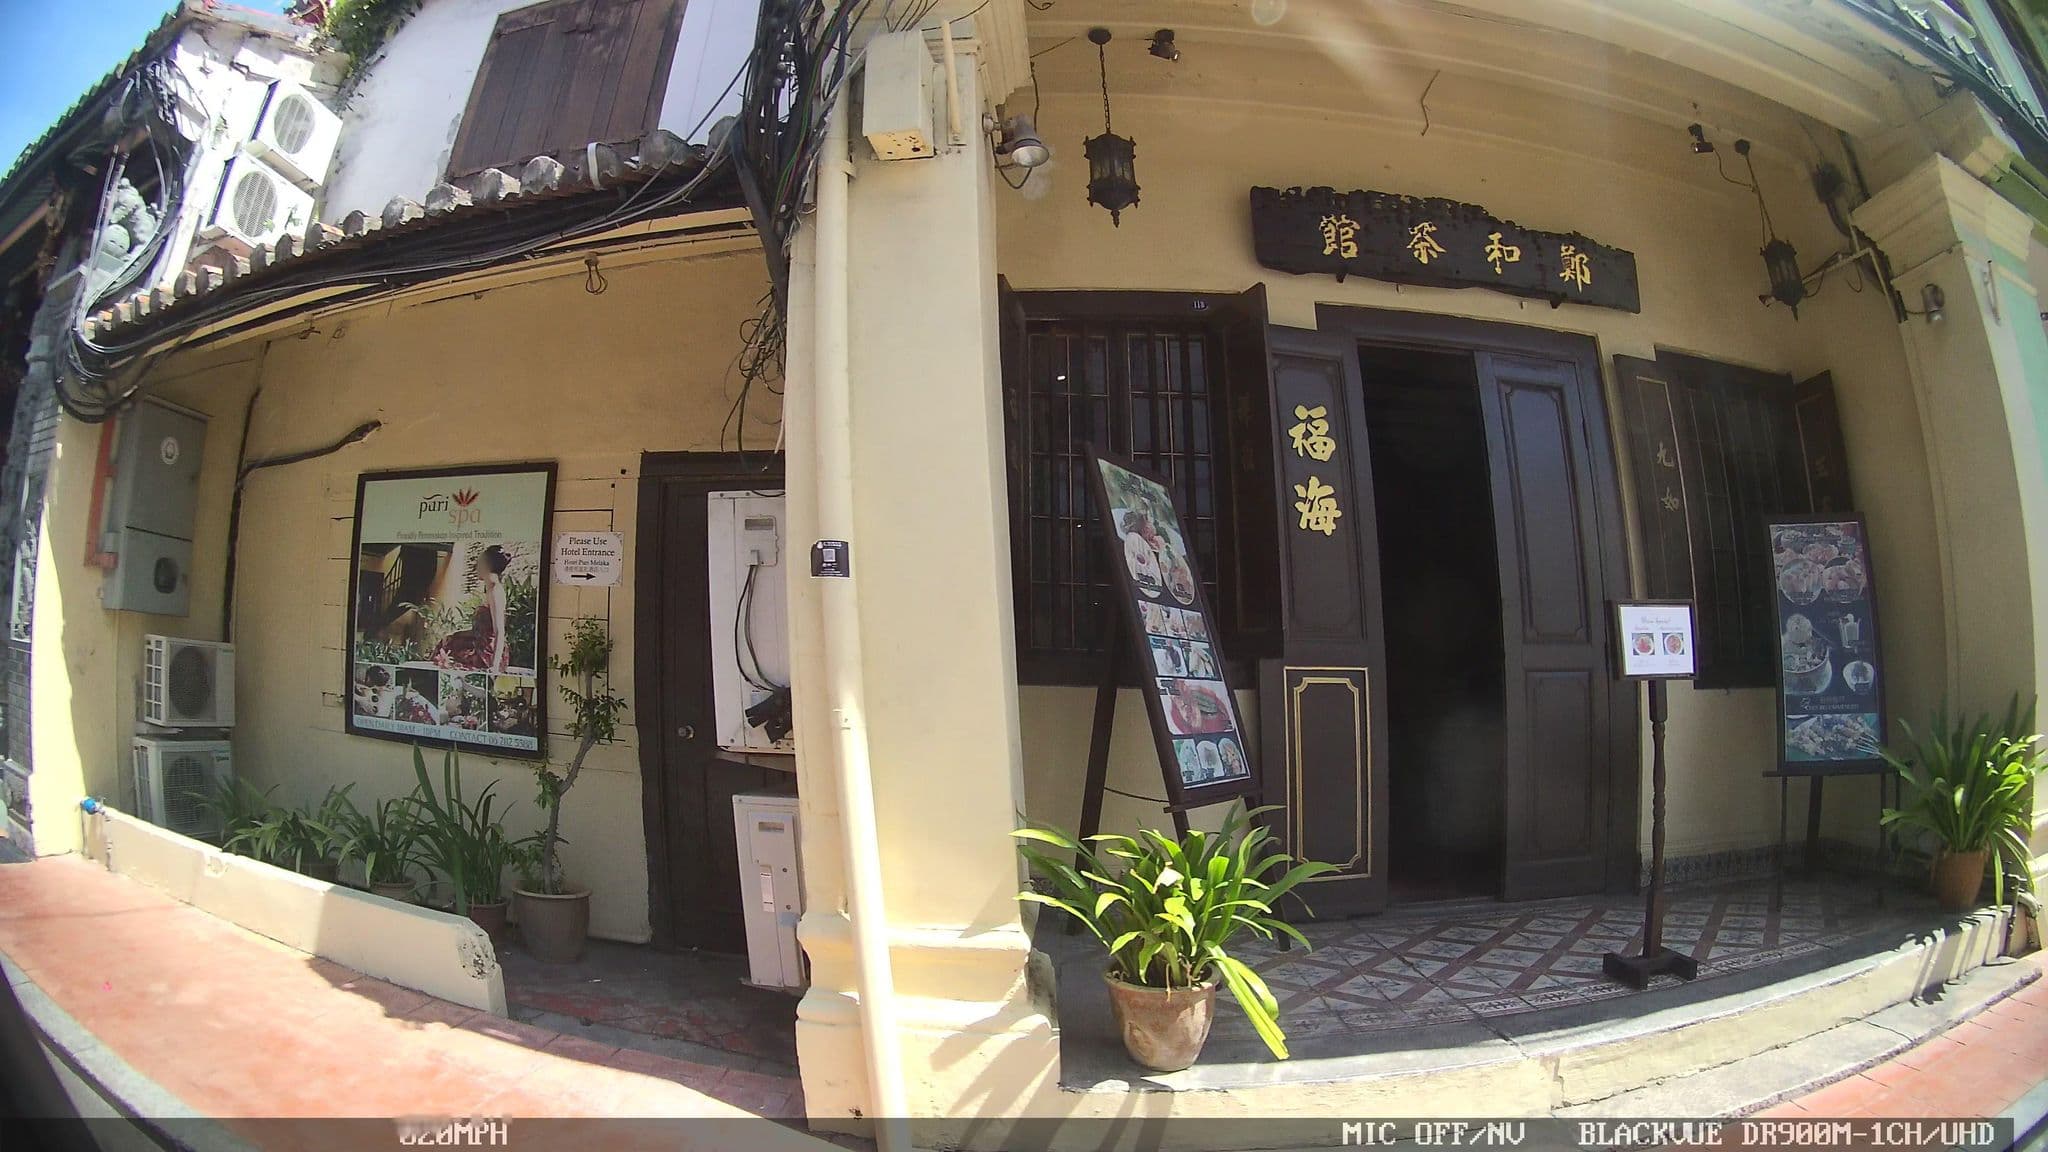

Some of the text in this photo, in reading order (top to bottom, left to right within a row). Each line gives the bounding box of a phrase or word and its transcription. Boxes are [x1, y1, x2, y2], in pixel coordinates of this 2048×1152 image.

[1287, 404, 1343, 536] 福海
[448, 508, 481, 529] spa
[569, 536, 608, 545] Please Use
[561, 547, 615, 557] Hotel Entrance
[449, 730, 488, 743] CONTACT
